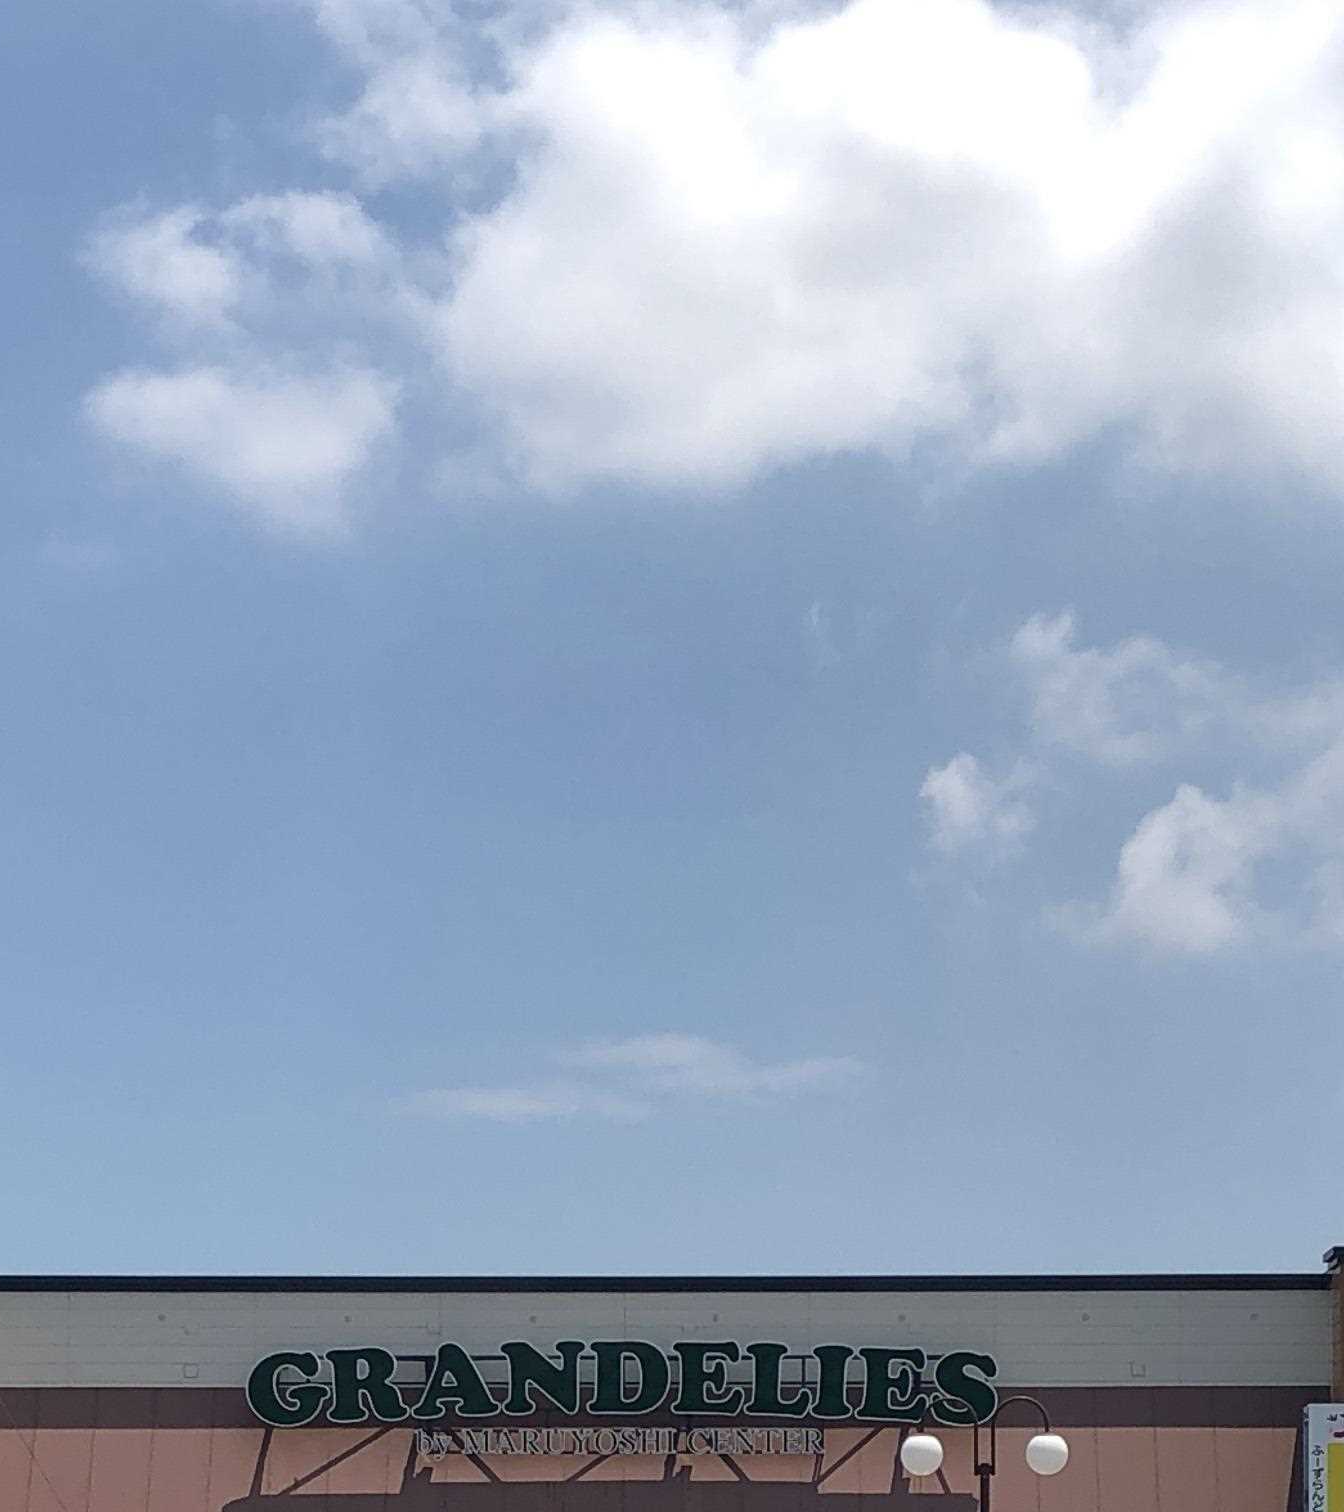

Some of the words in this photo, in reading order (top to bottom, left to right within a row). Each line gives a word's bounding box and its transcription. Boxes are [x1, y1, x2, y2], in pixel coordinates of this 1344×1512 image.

[246, 1338, 997, 1427] GRANDELIES
[417, 1428, 454, 1461] by
[460, 1428, 679, 1455] MARUYOSHI
[686, 1428, 825, 1455] CENTER
